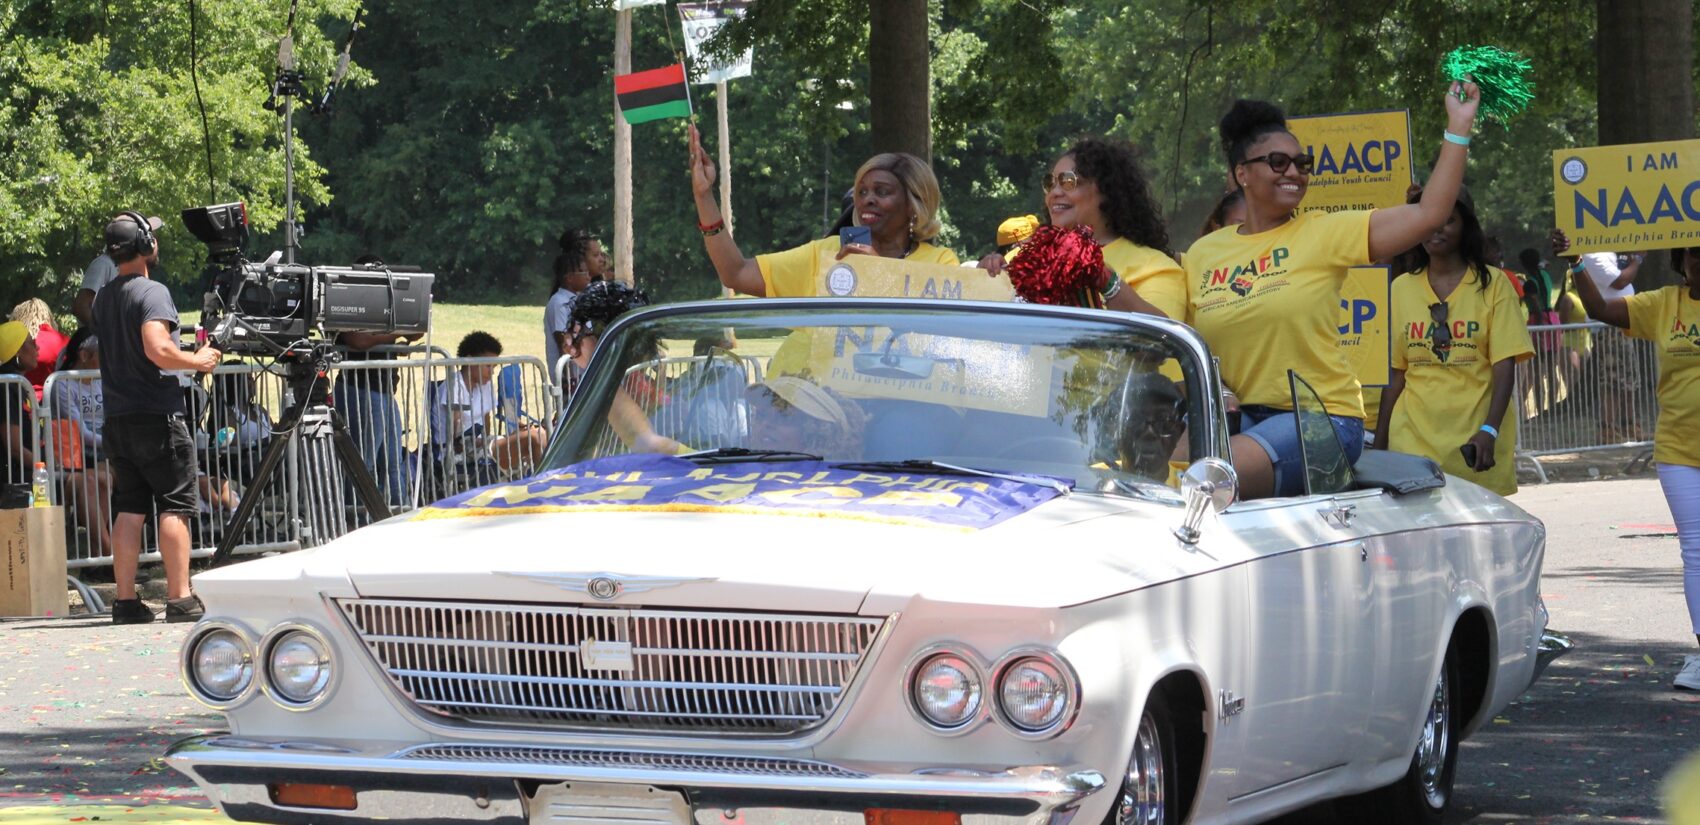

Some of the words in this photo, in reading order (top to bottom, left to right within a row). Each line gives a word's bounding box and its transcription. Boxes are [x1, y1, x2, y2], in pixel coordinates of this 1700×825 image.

[1627, 155, 1632, 172] I
[1643, 152, 1678, 171] AM
[1308, 175, 1339, 188] adelphia
[1342, 175, 1362, 185] Youth
[1364, 173, 1391, 184] Council
[1574, 180, 1700, 229] NAAC
[1576, 233, 1664, 246] Philadelphia
[1671, 230, 1700, 240] Bran
[1211, 247, 1290, 287] NAACP
[904, 274, 909, 295] I
[921, 277, 962, 299] AM
[1411, 320, 1480, 340] NACP
